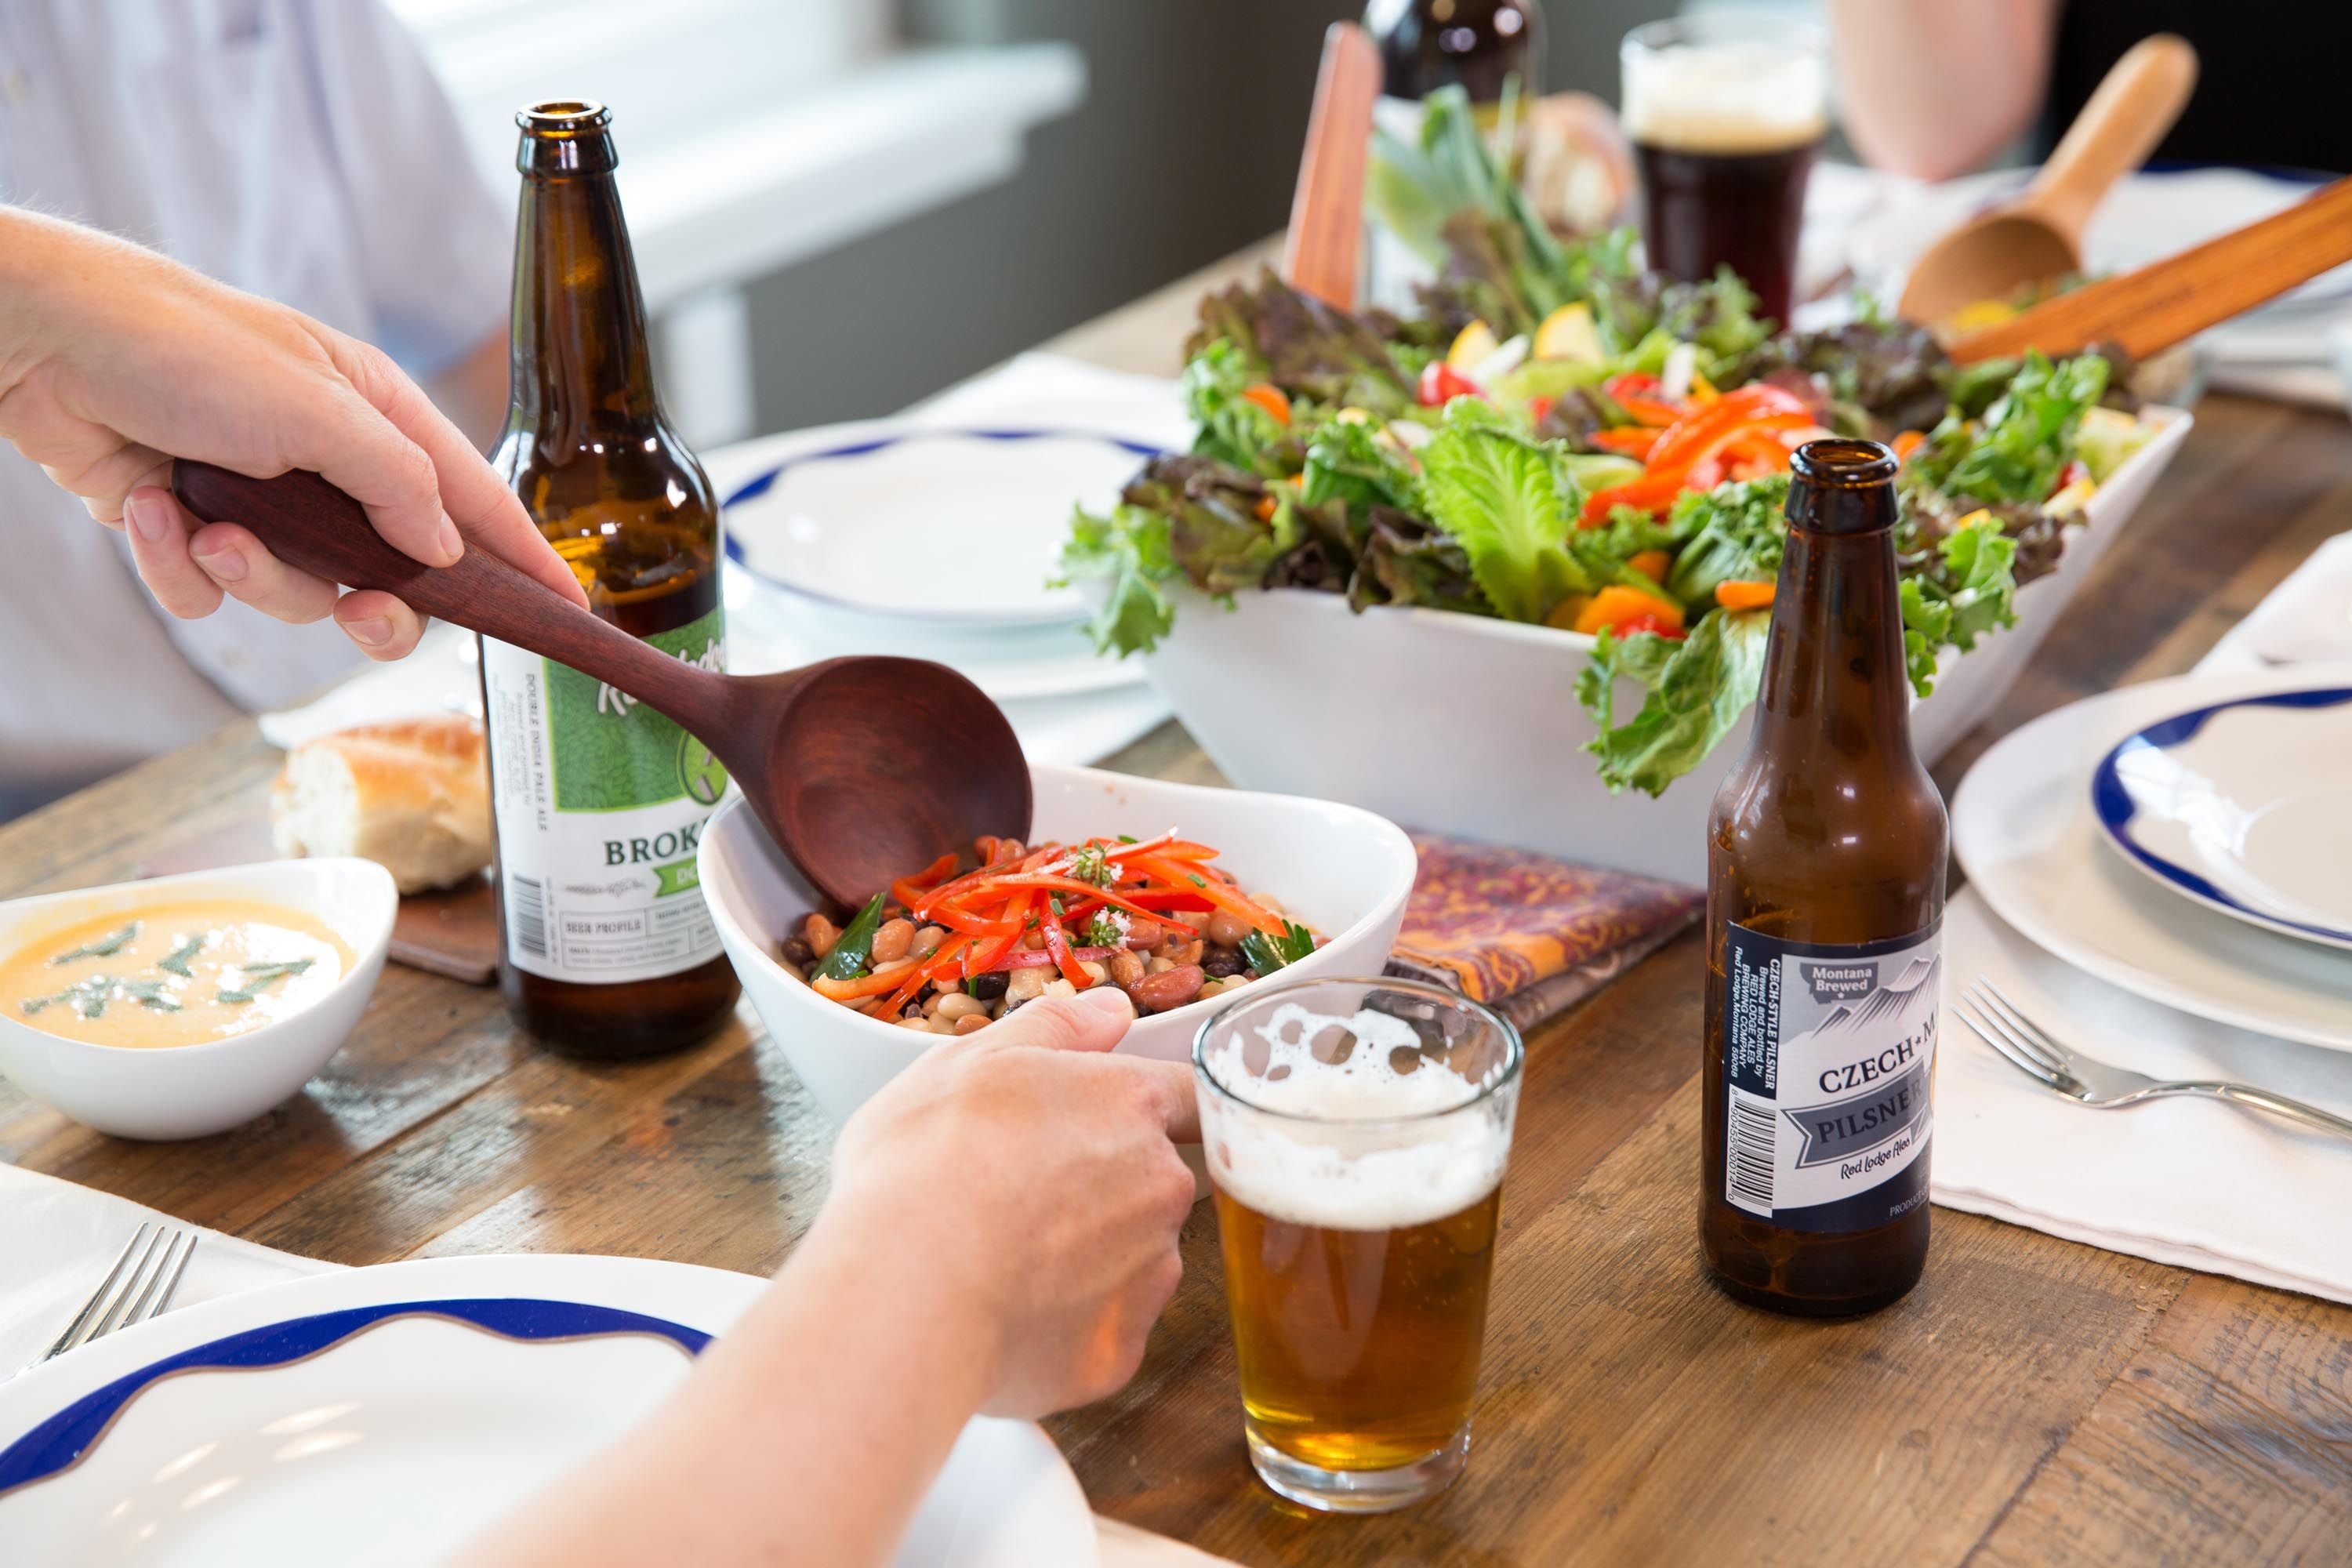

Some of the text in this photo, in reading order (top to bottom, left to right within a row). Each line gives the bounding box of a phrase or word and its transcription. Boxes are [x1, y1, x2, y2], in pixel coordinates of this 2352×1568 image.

[526, 673, 547, 832] DOUBLE INDIA PALE ALE
[604, 815, 710, 866] BROK
[565, 917, 641, 935] BEER PROFILE
[1733, 946, 1743, 967] Red
[1812, 966, 1872, 980] Montana
[1814, 978, 1869, 993] Brewed
[1739, 964, 1750, 1068] BREWING COMPANY
[1747, 974, 1759, 1065] RED LODGE ALES
[1753, 966, 1769, 1077] Brewed and bottled by
[1765, 958, 1781, 1090] CZECH-STYLE PILSNER
[1820, 1039, 1915, 1094] CZECH
[1815, 1078, 1923, 1145] PILSNER
[1841, 1137, 1911, 1180] Red Lodge Ales
